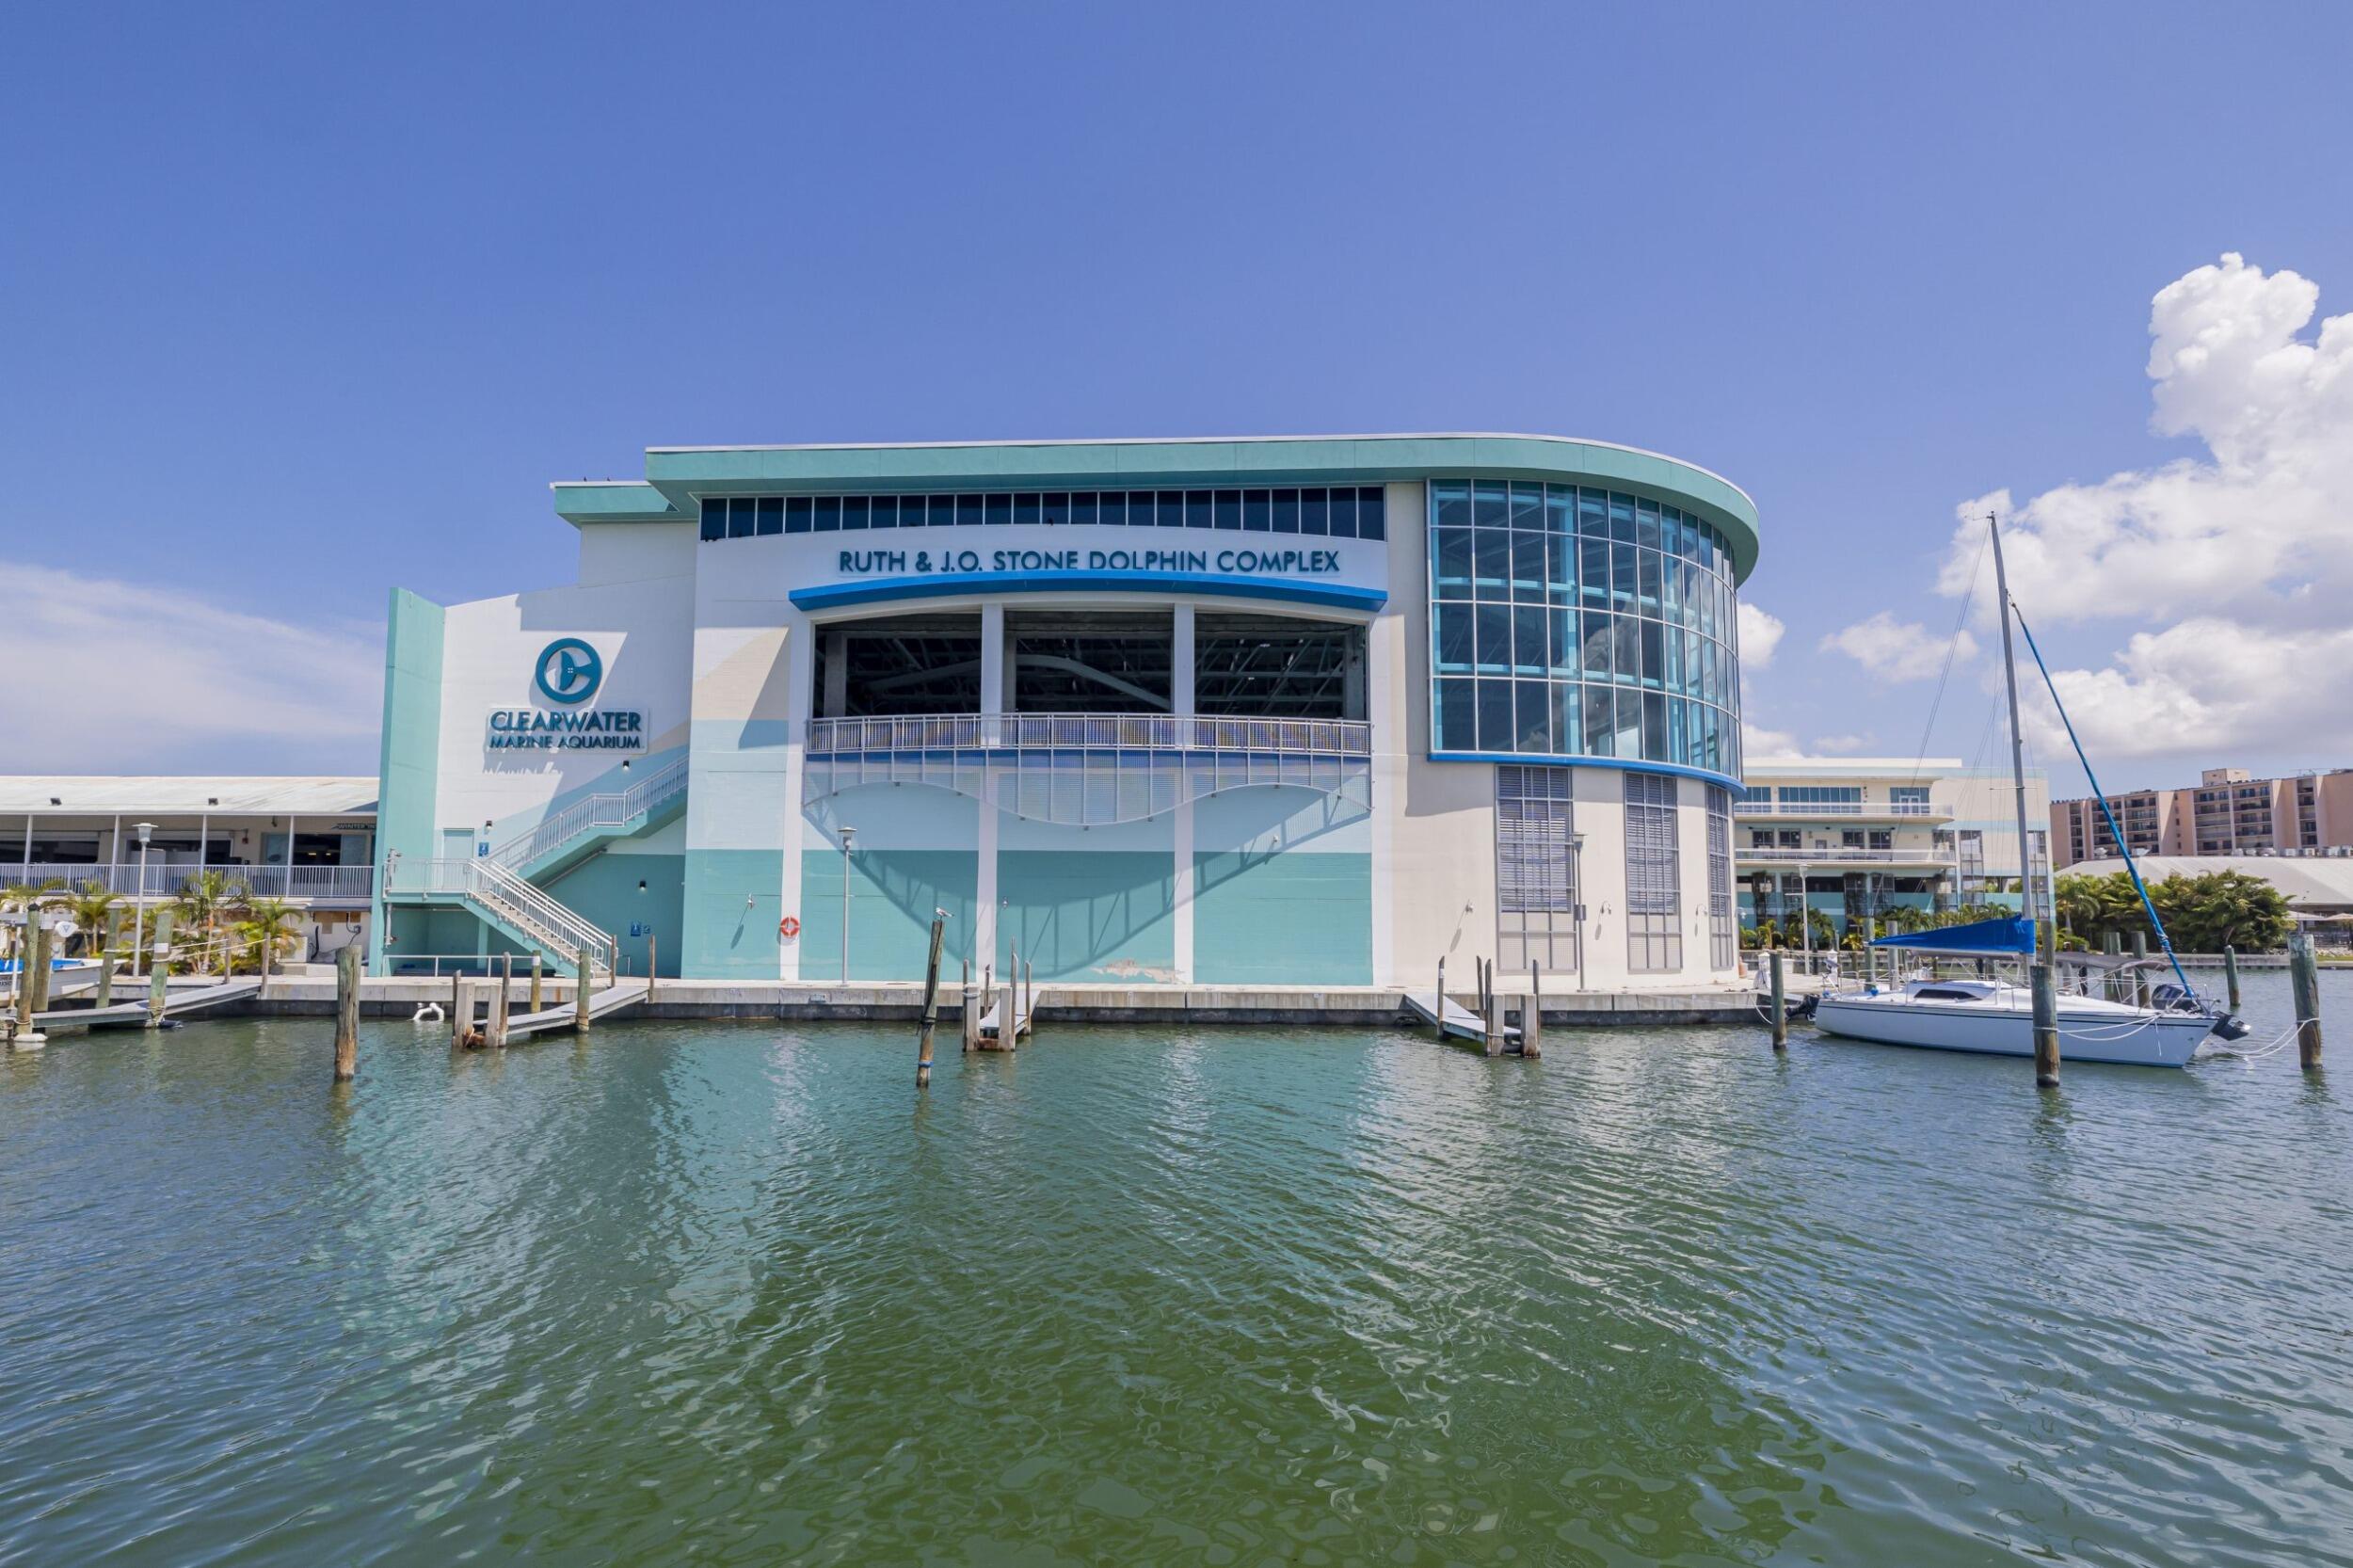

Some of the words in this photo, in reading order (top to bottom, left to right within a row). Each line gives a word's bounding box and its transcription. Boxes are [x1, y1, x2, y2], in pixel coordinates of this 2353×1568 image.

[840, 551, 905, 571] RUTH
[915, 552, 933, 571] &
[940, 551, 983, 571] J.O.
[993, 551, 1078, 570] STONE
[1089, 551, 1207, 570] DOLPHIN
[1217, 551, 1339, 571] COMPLEX
[490, 711, 641, 731] CLEARWATER
[489, 735, 552, 748] MARINE
[557, 735, 640, 748] AQUARIUM
